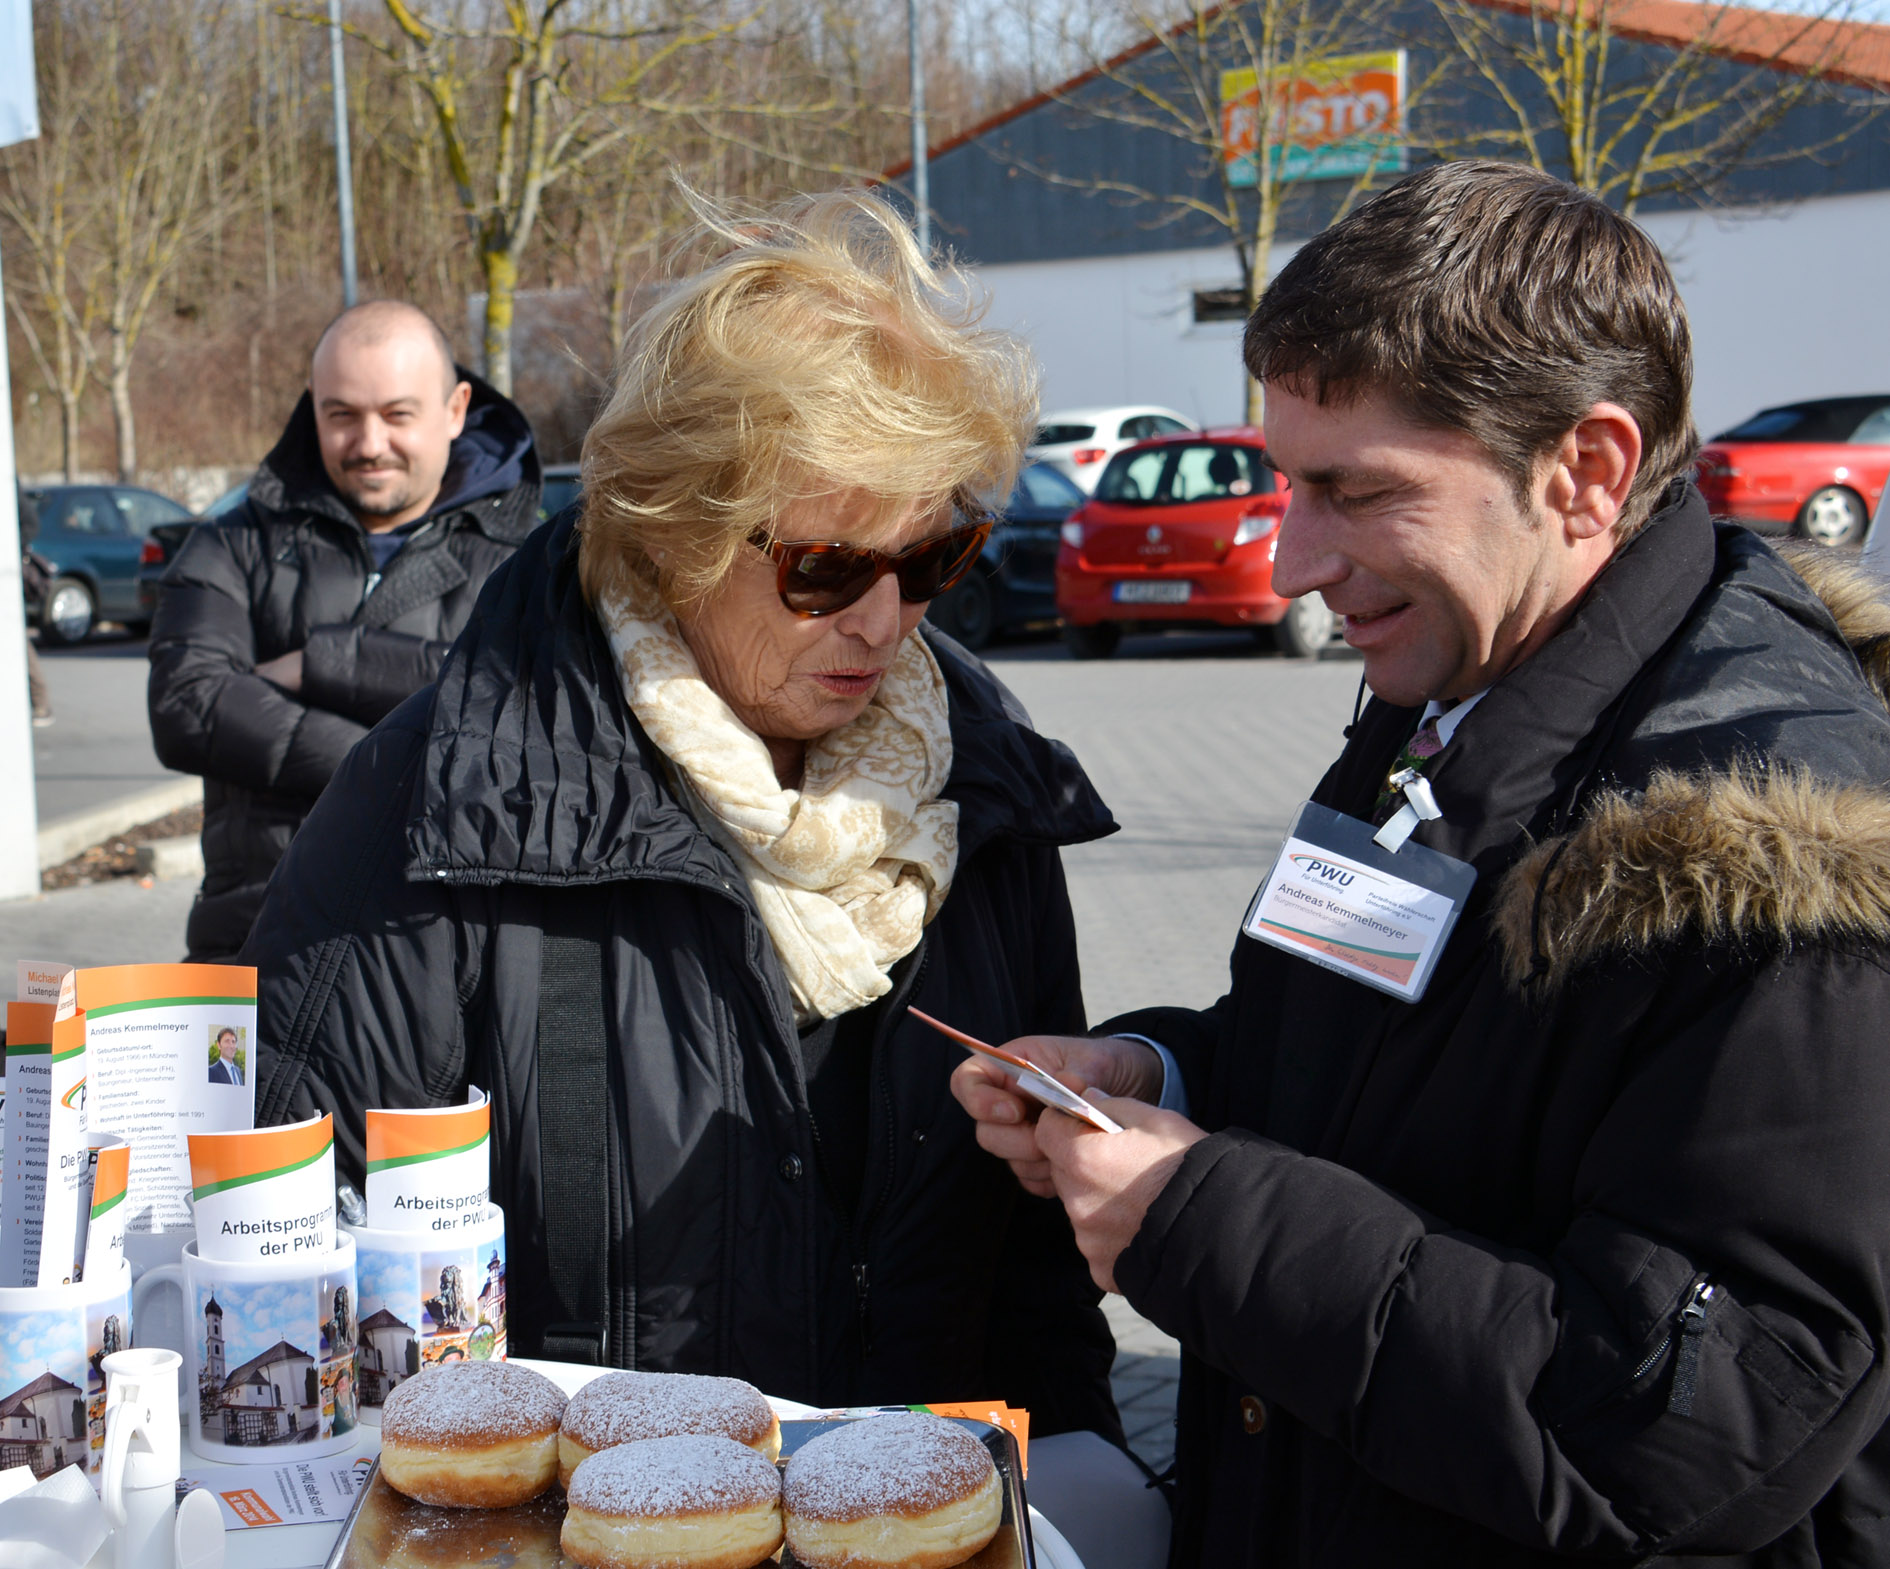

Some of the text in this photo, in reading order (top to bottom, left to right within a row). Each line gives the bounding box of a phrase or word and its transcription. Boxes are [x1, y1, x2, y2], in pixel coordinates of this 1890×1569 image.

[1307, 860, 1355, 886] PWU
[1274, 895, 1347, 928] Bürgermeisterkandidat
[1278, 883, 1408, 940] Andreas Kemmelmeyer
[28, 971, 58, 984] Michael
[91, 1023, 189, 1036] Andreas Kemmelmeyer
[19, 1065, 51, 1075] Andreas
[60, 1155, 76, 1168] Die
[432, 1218, 458, 1230] der
[260, 1232, 323, 1256] der PWU
